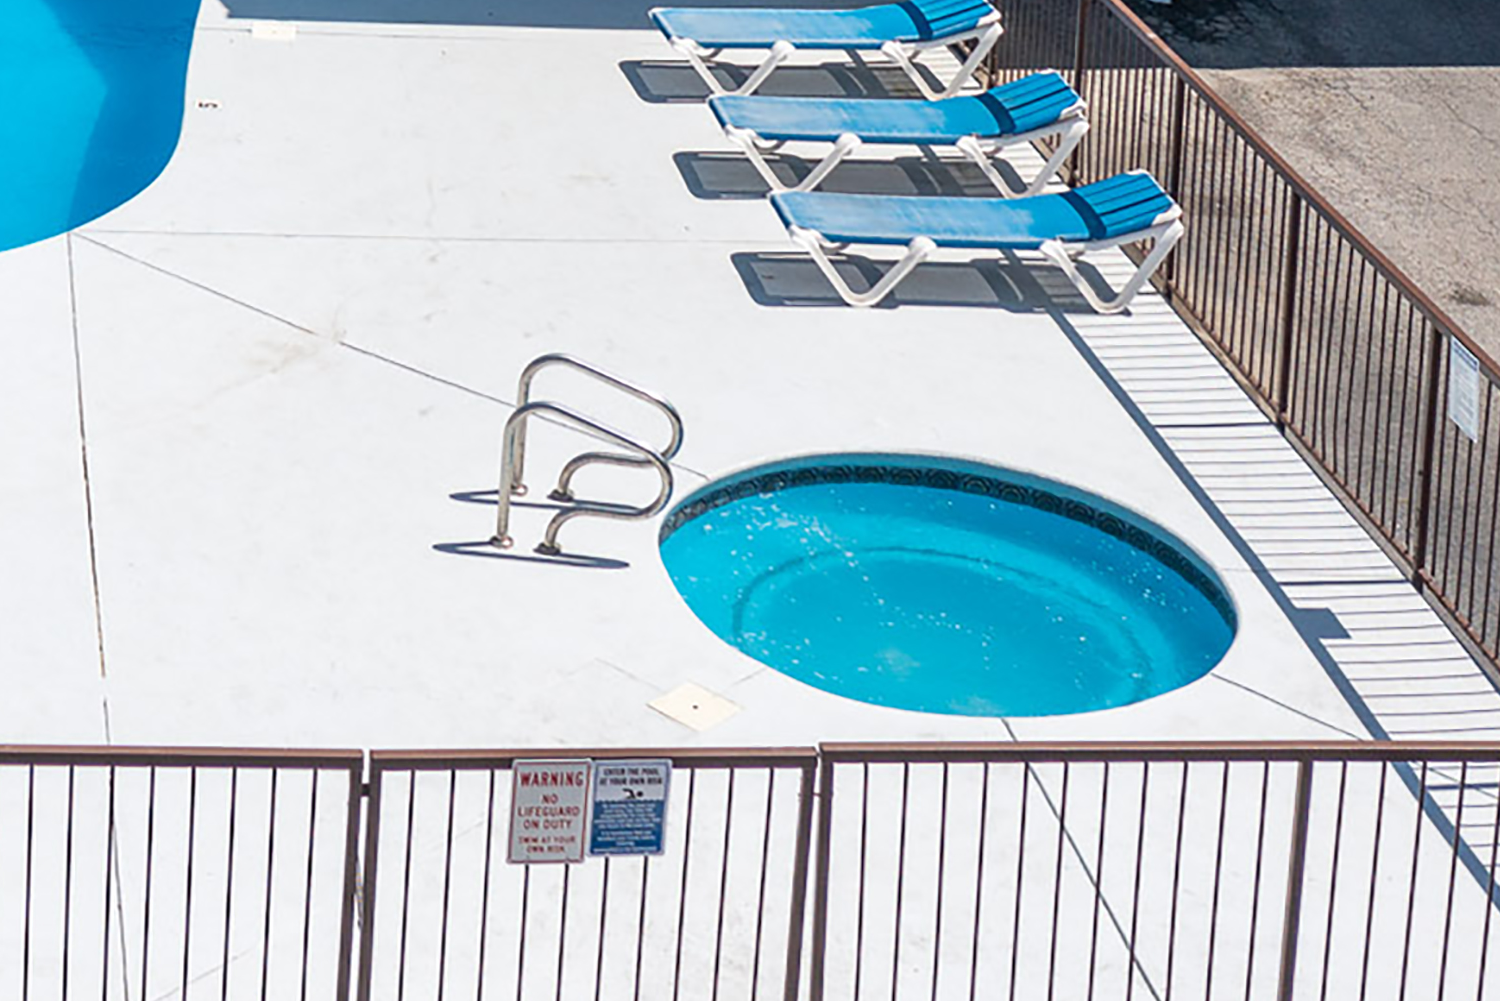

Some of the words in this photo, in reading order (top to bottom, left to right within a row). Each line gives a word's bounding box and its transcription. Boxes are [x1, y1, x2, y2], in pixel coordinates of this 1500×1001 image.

[519, 771, 584, 787] WARNING
[541, 793, 559, 804] NO
[517, 806, 580, 817] LIFEGUARD
[523, 819, 539, 830] ON
[543, 819, 572, 830] DUTY
[518, 836, 538, 844] SWIM
[553, 835, 575, 843] YOUR
